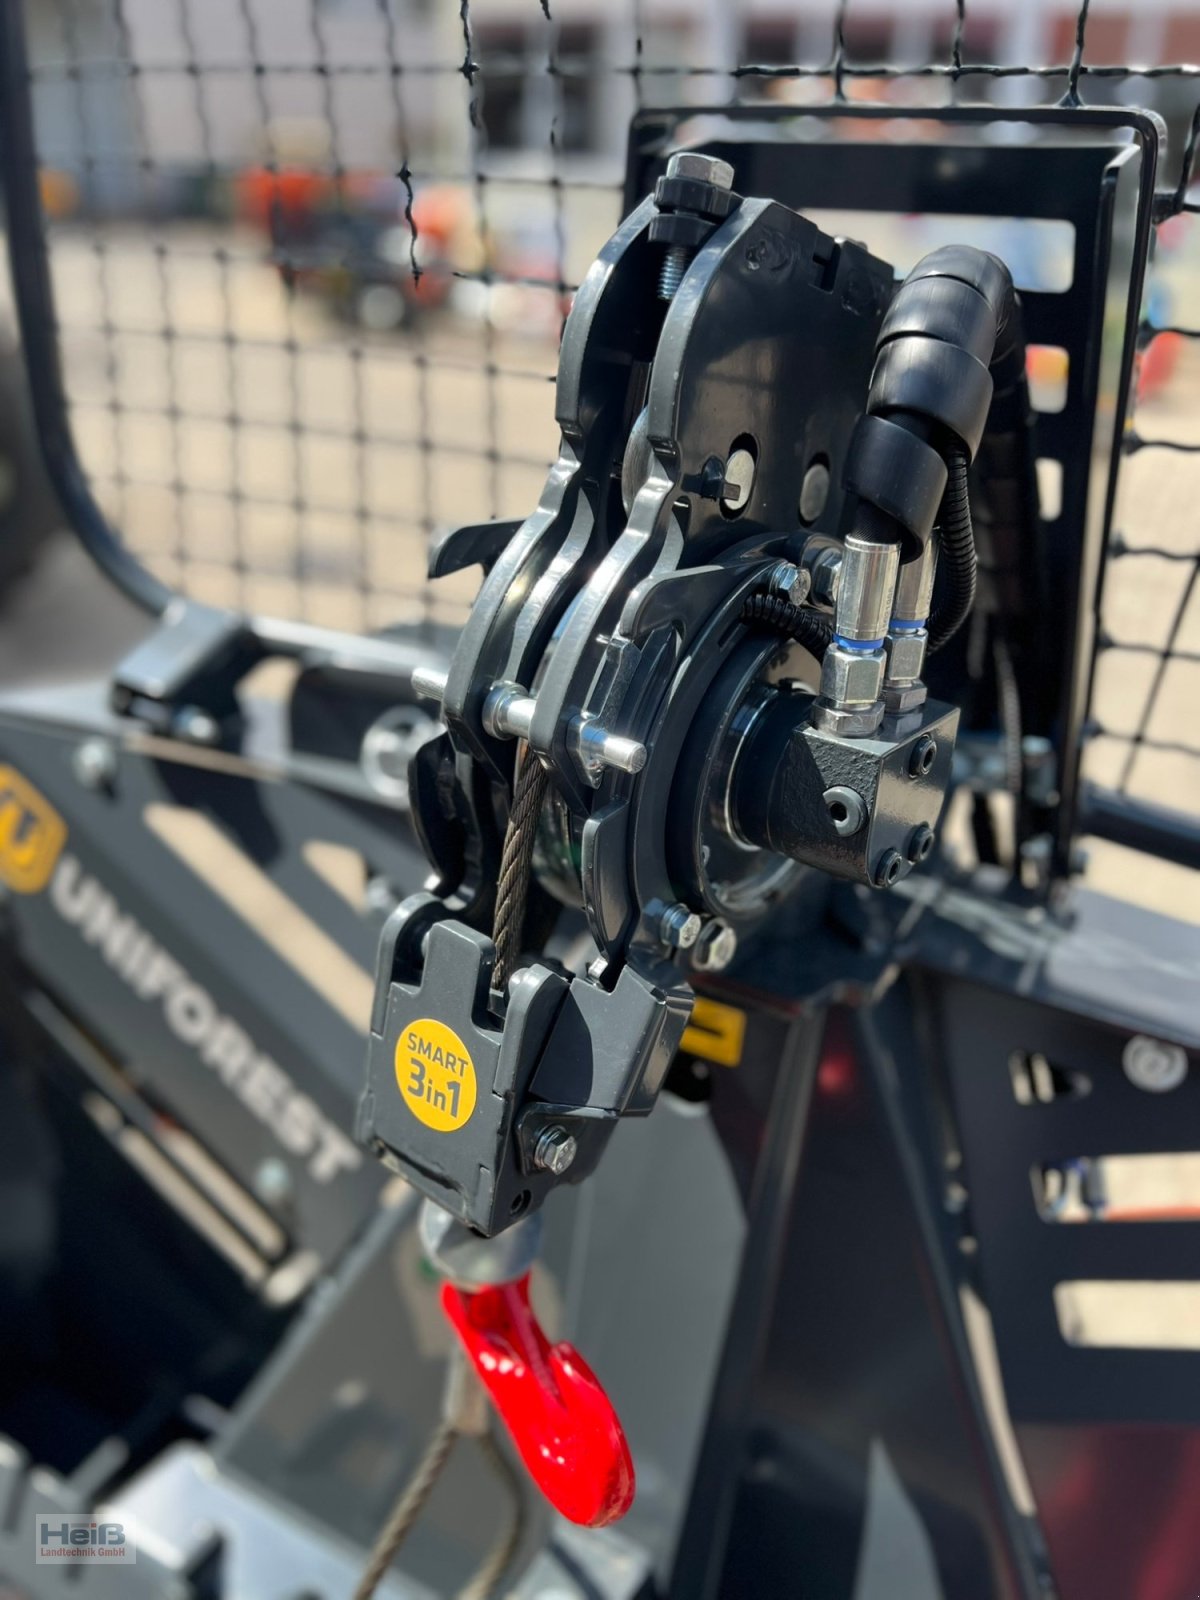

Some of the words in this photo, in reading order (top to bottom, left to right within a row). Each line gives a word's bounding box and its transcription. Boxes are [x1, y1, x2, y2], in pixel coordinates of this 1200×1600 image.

[51, 853, 362, 1183] UNIFOREST
[407, 1032, 469, 1077] SMART
[407, 1057, 461, 1118] 3in1
